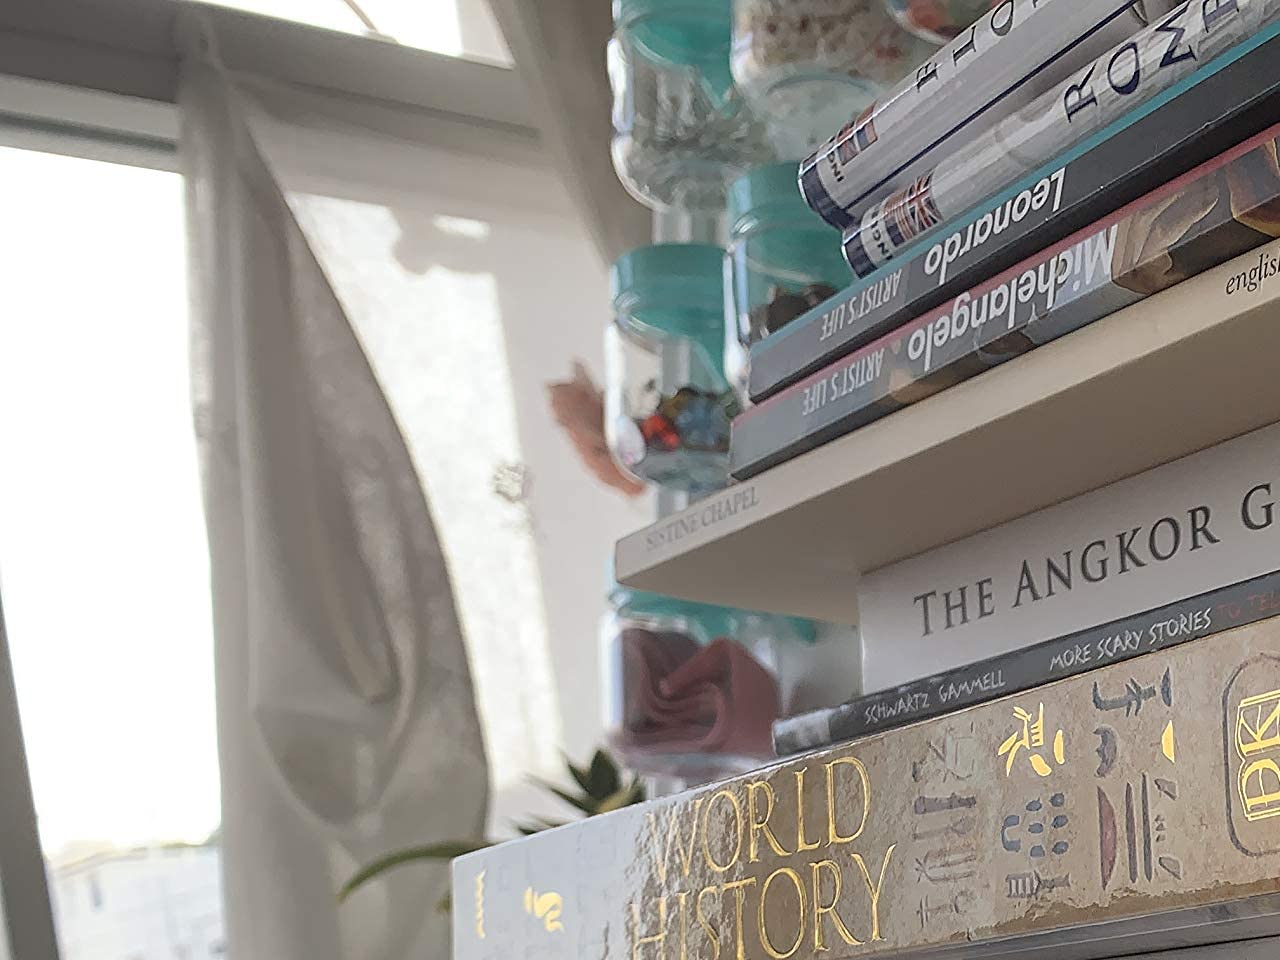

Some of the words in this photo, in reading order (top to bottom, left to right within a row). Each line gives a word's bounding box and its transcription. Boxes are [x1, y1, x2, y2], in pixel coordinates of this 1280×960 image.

[905, 0, 1038, 93] FLO
[924, 167, 1066, 285] Leonardo
[819, 305, 847, 341] LIFE
[847, 268, 904, 325] ARTIST'S
[907, 223, 1118, 371] Michelangelo
[802, 381, 829, 416] LIFE
[831, 347, 885, 406] ARTIST'S
[645, 511, 702, 552] SISTINE
[699, 486, 760, 528] CHAPEL
[912, 576, 995, 637] THE
[1011, 505, 1220, 609] ANGKOR
[1049, 644, 1091, 669] MORE
[1096, 630, 1145, 660] SCARY
[1148, 607, 1213, 645] STORIES
[1217, 603, 1241, 619] TO
[864, 689, 931, 725] SCHWARTZ
[938, 669, 1006, 703] GAMMELL
[645, 755, 871, 883] WORLD
